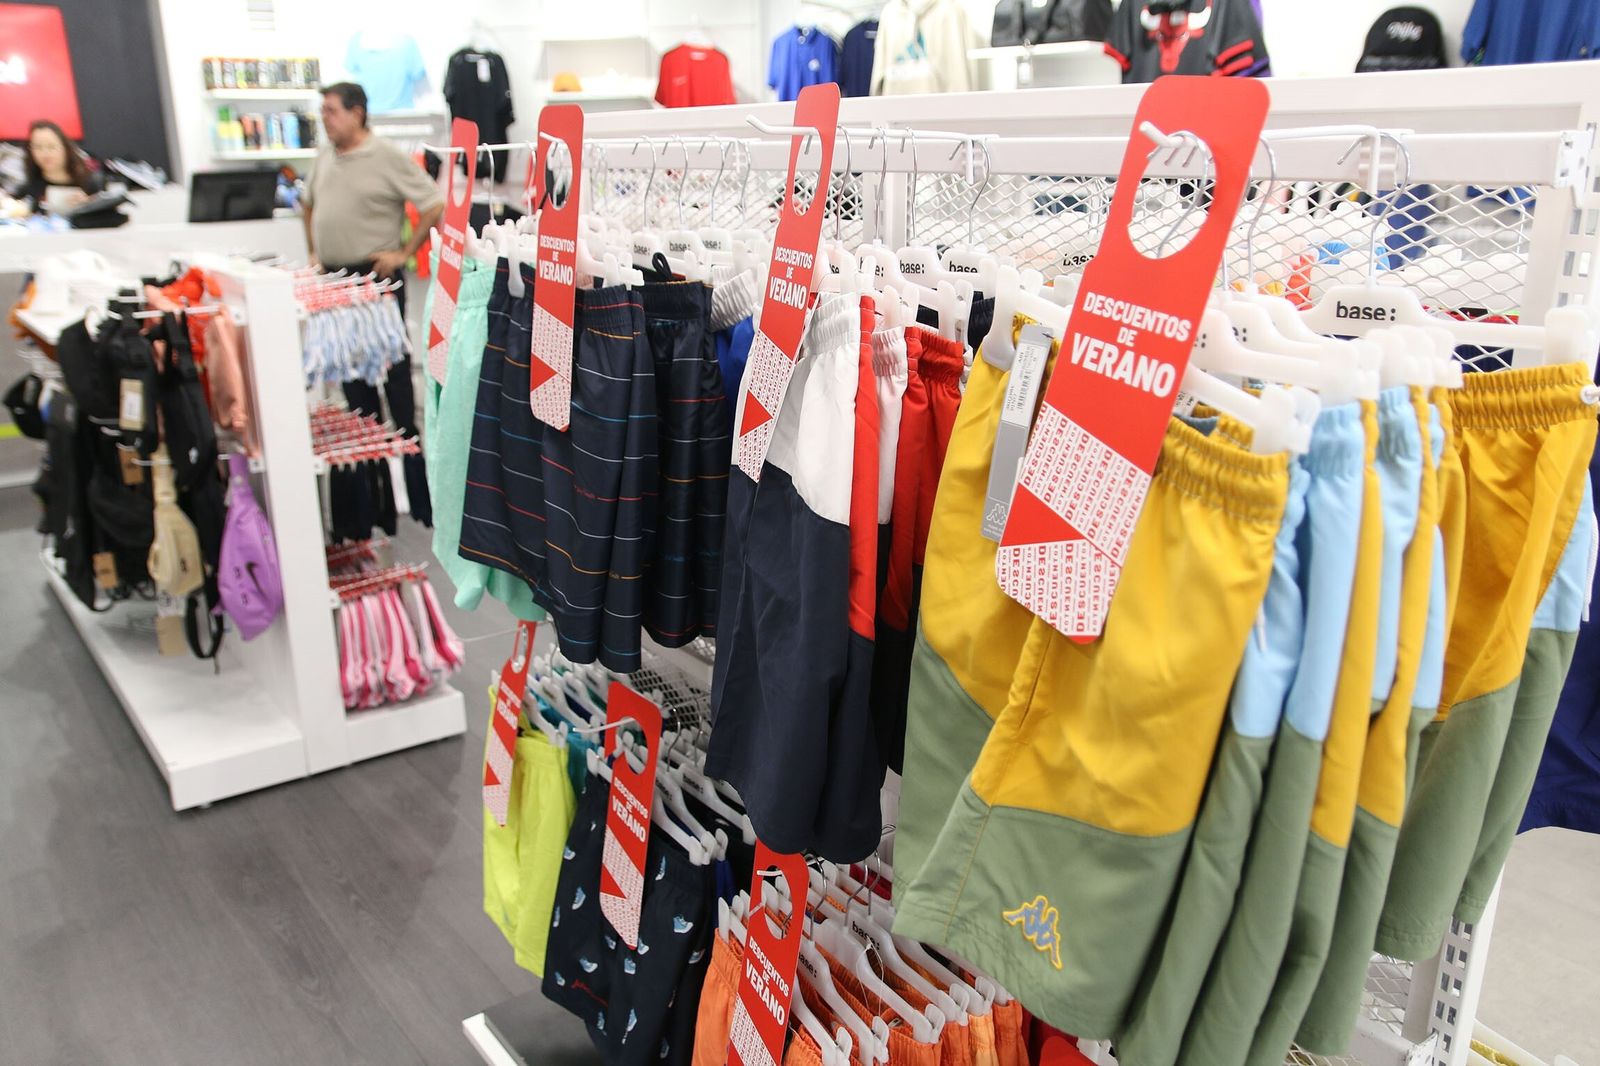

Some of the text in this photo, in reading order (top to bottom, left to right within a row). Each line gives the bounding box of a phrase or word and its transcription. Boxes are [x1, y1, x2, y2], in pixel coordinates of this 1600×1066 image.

[774, 246, 813, 269] DESCUENTOS
[900, 260, 925, 274] base:
[539, 259, 573, 286] VERANO
[785, 267, 794, 279] DE
[769, 276, 807, 310] VERANO
[1082, 291, 1192, 342] DESCUENTOS
[1336, 300, 1396, 321] base:
[1116, 326, 1138, 347] DE
[1070, 332, 1176, 398] VERANO
[612, 795, 646, 842] VERANO
[749, 936, 789, 997] DESCUENTOS
[762, 969, 770, 985] DE
[798, 952, 818, 978] ase:
[745, 958, 785, 1026] VERANO
